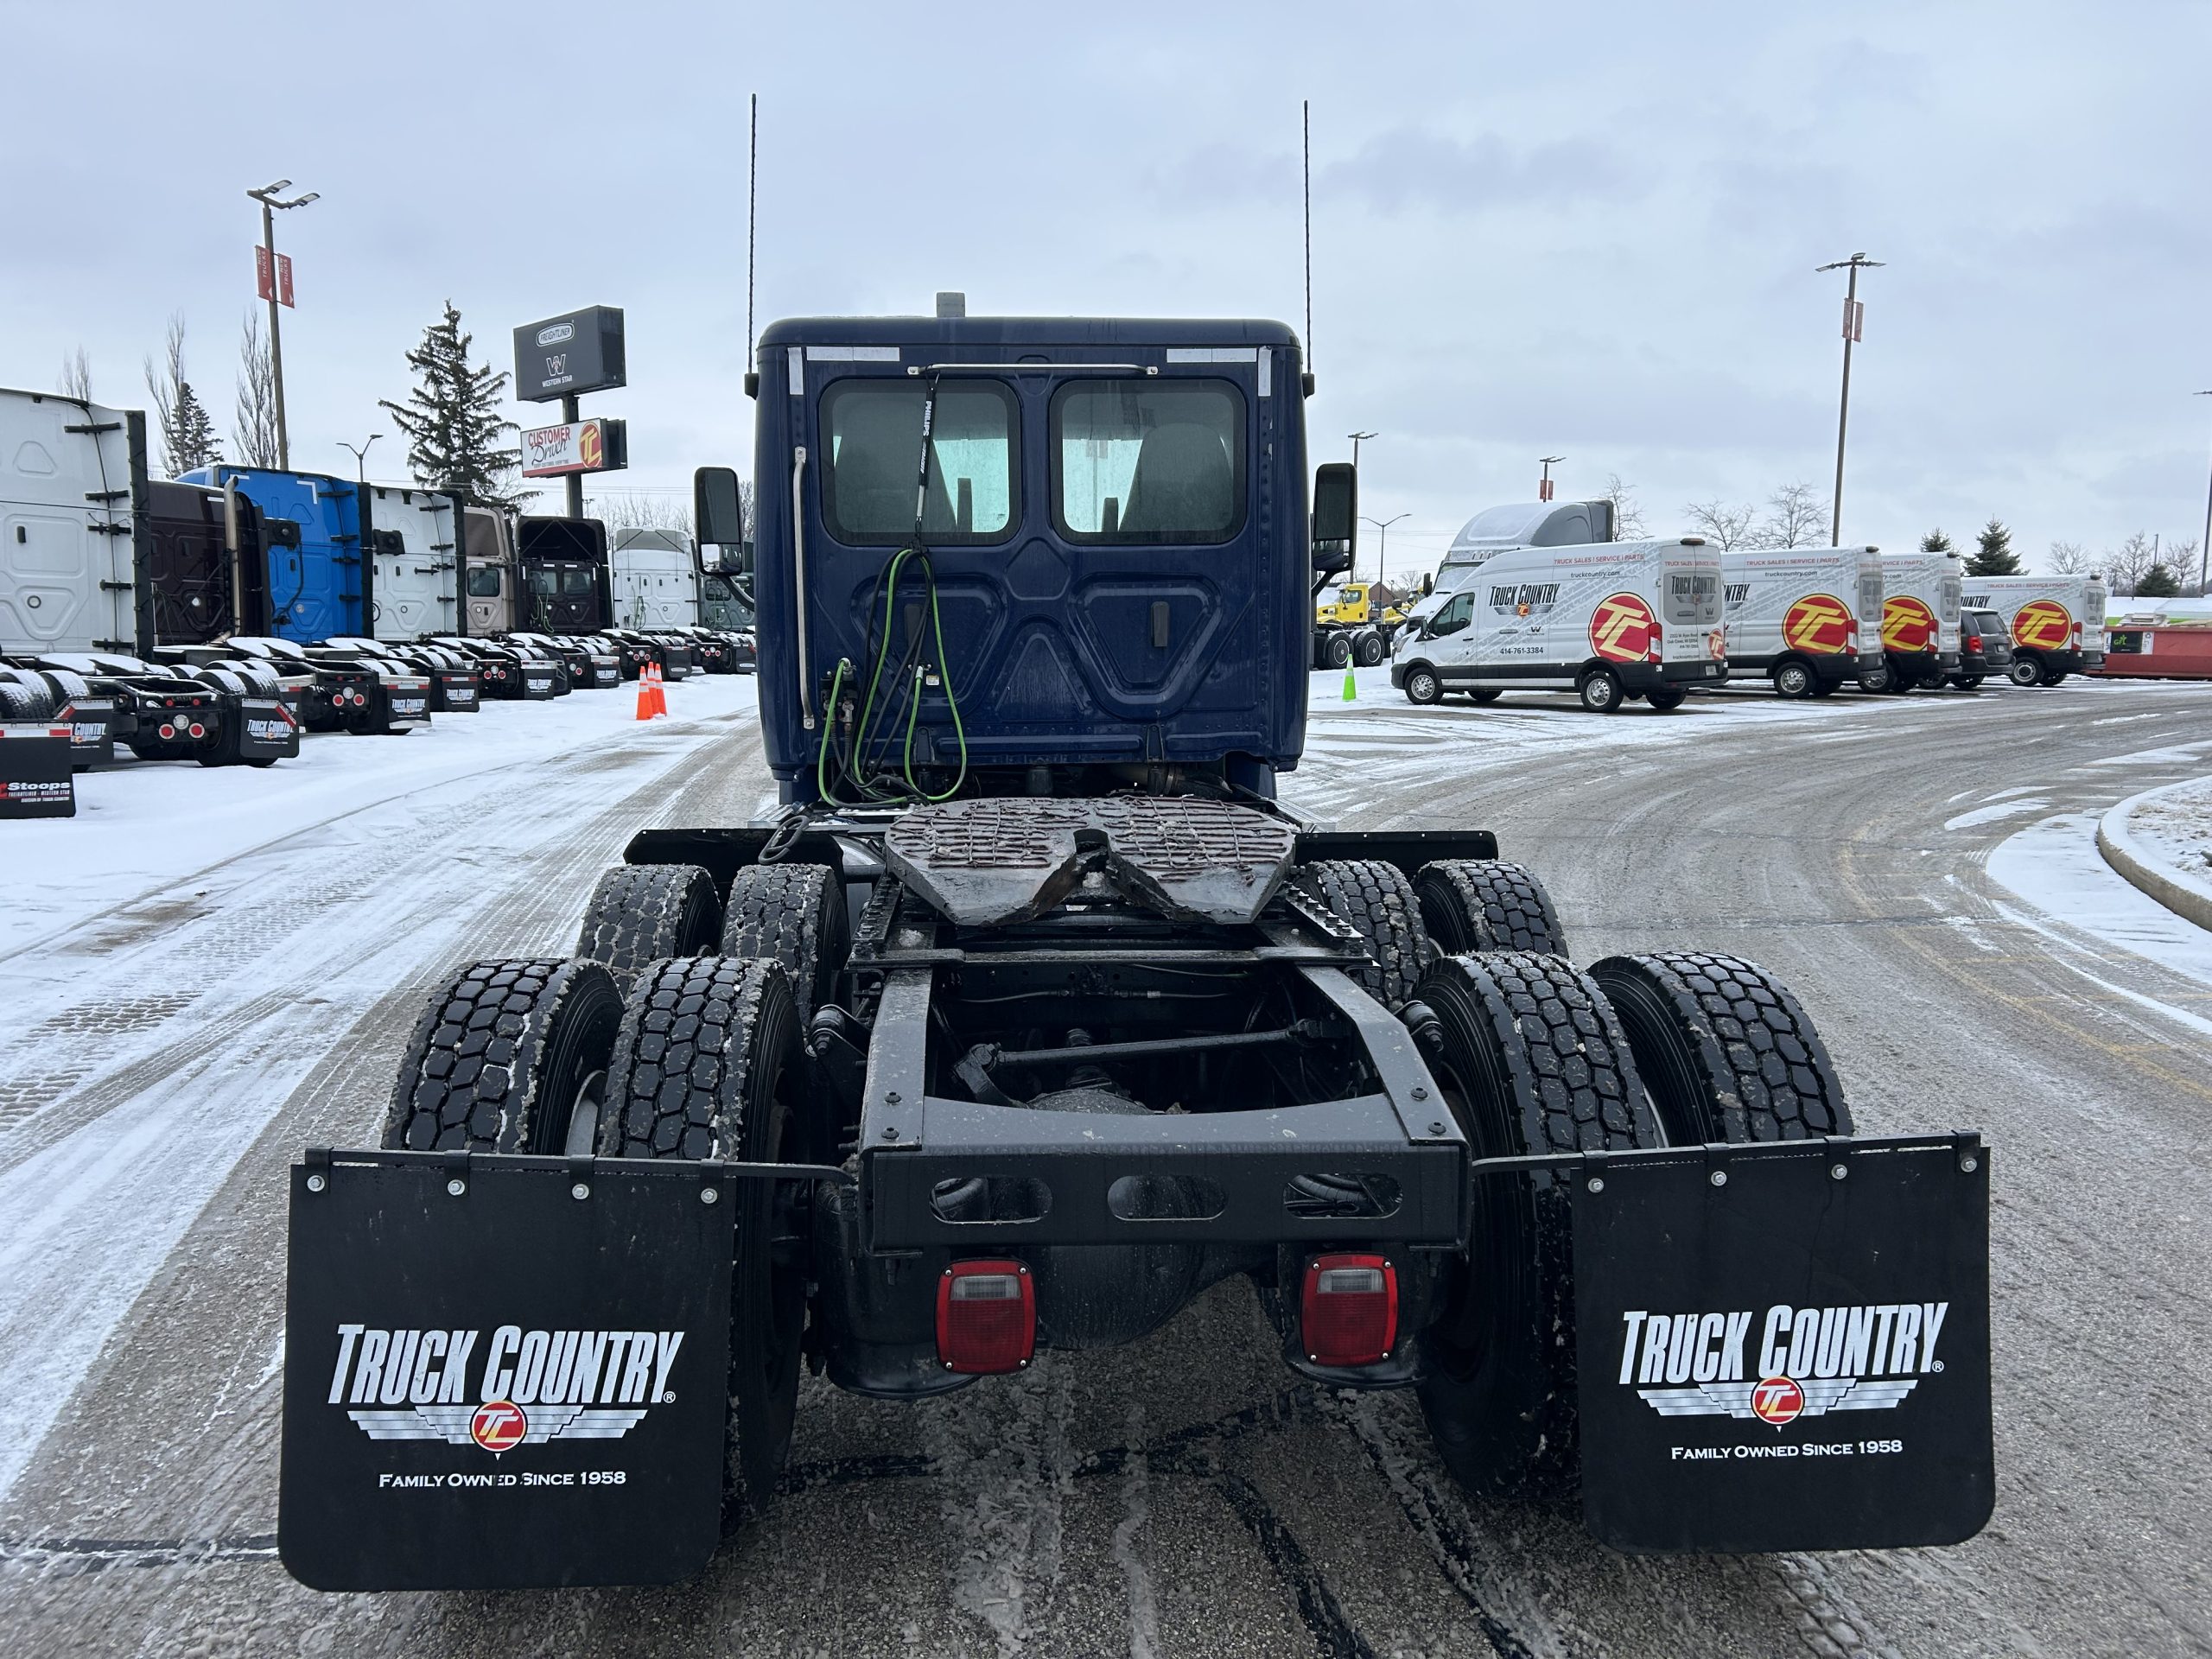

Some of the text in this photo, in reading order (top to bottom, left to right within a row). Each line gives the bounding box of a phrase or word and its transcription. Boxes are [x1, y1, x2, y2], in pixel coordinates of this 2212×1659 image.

[539, 327, 571, 343] FREIGHTLINER
[542, 375, 573, 388] WESTERN STAR
[528, 426, 571, 447] CUSTOMER
[531, 438, 568, 466] Driven
[1671, 575, 1717, 595] TRUCK COUNTRY
[1724, 583, 1751, 602] NTRY
[1489, 583, 1560, 606] TRUCK COUNTRY
[1961, 595, 1991, 608] UNTRY
[1500, 646, 1544, 655] 414-761-3384
[74, 722, 106, 735] COUNTRY
[246, 719, 269, 732] TRUCK
[7, 782, 71, 791] Stoops
[1618, 1301, 1949, 1385] TRUCK COUNTRY
[327, 1324, 685, 1404] TRUCK COUNTRY
[1670, 1440, 1904, 1460] FAMILY OWNED SINCE 1958
[378, 1471, 627, 1488] FAMILY OWNED SINCE 1958
